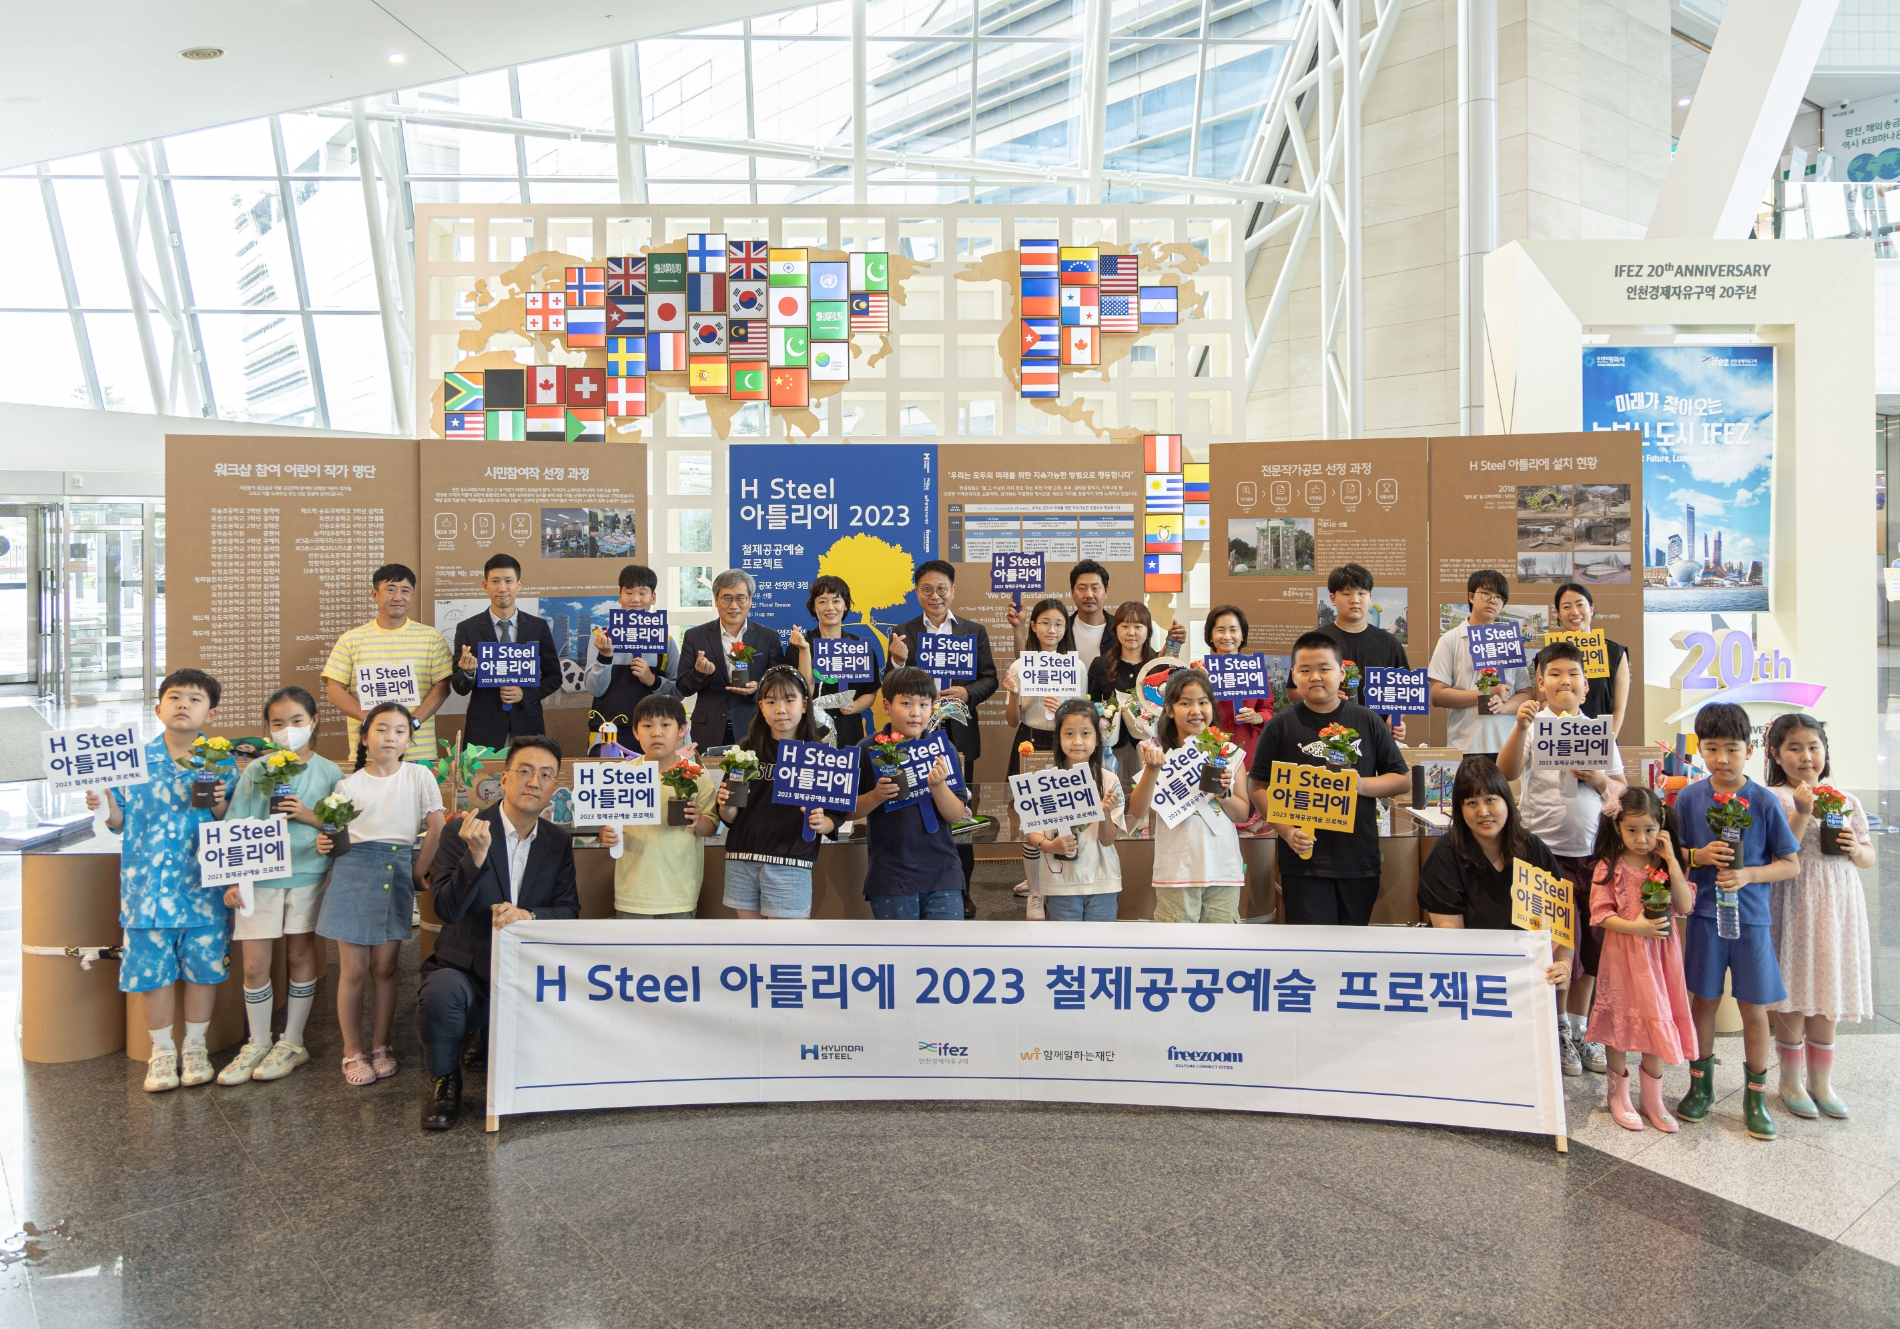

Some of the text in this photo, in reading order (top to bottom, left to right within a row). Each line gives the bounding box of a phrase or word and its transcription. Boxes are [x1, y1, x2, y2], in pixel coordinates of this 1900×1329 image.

[1845, 126, 1864, 138] 환전,
[1842, 139, 1858, 149] 역시
[1615, 262, 1771, 277] IFEZ 20th ANNIVERSARY
[1626, 285, 1756, 300] 인천경제자유구역 20주년
[1712, 357, 1729, 366] ifez
[1615, 392, 1723, 416] 미래가 찾아오는
[1657, 422, 1694, 446] 도시
[1701, 422, 1751, 446] IFEZ
[1470, 456, 1598, 471] H Steel 아틀리에 설치 현황
[1646, 454, 1707, 463] Future, Luminous
[214, 463, 376, 479] 워크샵 참여 어린이 작가 명단
[484, 466, 590, 480] 시민참여작 선정 과정
[973, 471, 993, 480] 모두의
[996, 471, 1015, 480] 미래를
[1018, 471, 1032, 480] 위한
[1034, 471, 1067, 480] 지속가능한
[1069, 471, 1095, 479] 방법으로
[1261, 462, 1372, 477] 전문작가공모 선정 과정
[741, 478, 835, 499] H Steel
[740, 503, 910, 530] 아틀리에 2023
[742, 544, 804, 556] 철제공공예술
[742, 558, 783, 570] 프로젝트
[995, 556, 1040, 567] H Steel
[994, 568, 1042, 582] 아틀리에
[758, 582, 772, 590] 공모
[774, 582, 795, 590] 선정작
[614, 613, 664, 626] H Steel
[611, 626, 665, 643] 아틀리에
[1471, 626, 1518, 641] H Steel
[818, 642, 868, 654] H Steel
[922, 637, 932, 650] H
[938, 636, 973, 651] Steel
[1472, 640, 1522, 659] 아틀리에
[482, 646, 535, 659] H Steel
[920, 651, 973, 668] 아틀리에
[1682, 629, 1792, 690] 20th
[480, 660, 536, 676] 아틀리에
[817, 656, 870, 671] 아틀리에
[1024, 656, 1074, 667] H Steel
[1208, 656, 1261, 671] H Steel
[360, 665, 410, 681] H Steel
[1023, 670, 1076, 684] 아틀리에
[1209, 671, 1265, 689] 아틀리에
[1370, 671, 1424, 685] H Steel
[361, 680, 415, 698] 아틀리에
[1368, 686, 1425, 703] 아틀리에
[1540, 721, 1607, 736] H Steel
[49, 728, 134, 753] H Steel
[1538, 738, 1609, 757] 아틀리에
[50, 748, 140, 776] 아틀리에
[782, 746, 853, 769] H Steel
[74, 774, 113, 787] 철제공공예술
[116, 771, 142, 781] 프로젝트
[580, 767, 653, 785] H Steel
[778, 766, 853, 795] 아틀리에
[1016, 769, 1087, 796] H Steel
[1276, 768, 1350, 792] H Steel
[578, 787, 655, 809] 아틀리에
[794, 793, 826, 803] 철제공공예술
[828, 796, 851, 806] 프로젝트
[1020, 788, 1095, 817] 아틀리에
[1272, 788, 1350, 816] 아틀리에
[595, 812, 630, 820] 철제공공예술
[1026, 810, 1098, 828] 2023 철제공공예술 프로젝트
[1168, 810, 1181, 820] 2023
[1289, 813, 1324, 824] 철제공공예술
[1325, 818, 1348, 826] 프로젝트
[206, 820, 281, 845] H Steel
[204, 840, 285, 868] 아틀리에
[753, 854, 783, 864] WHATEVER
[785, 858, 796, 866] YOU
[224, 868, 260, 879] 철제공공예술
[262, 865, 286, 874] 프로젝트
[1518, 866, 1569, 904] H Steel
[1516, 888, 1570, 930] 아틀리에
[536, 962, 1513, 1021] H Steel 아틀리에 2023 철제공공예술 프로젝트
[938, 1042, 969, 1056] ifez
[1043, 1050, 1116, 1062] 함께일하는재단
[1167, 1046, 1243, 1063] freezoom
